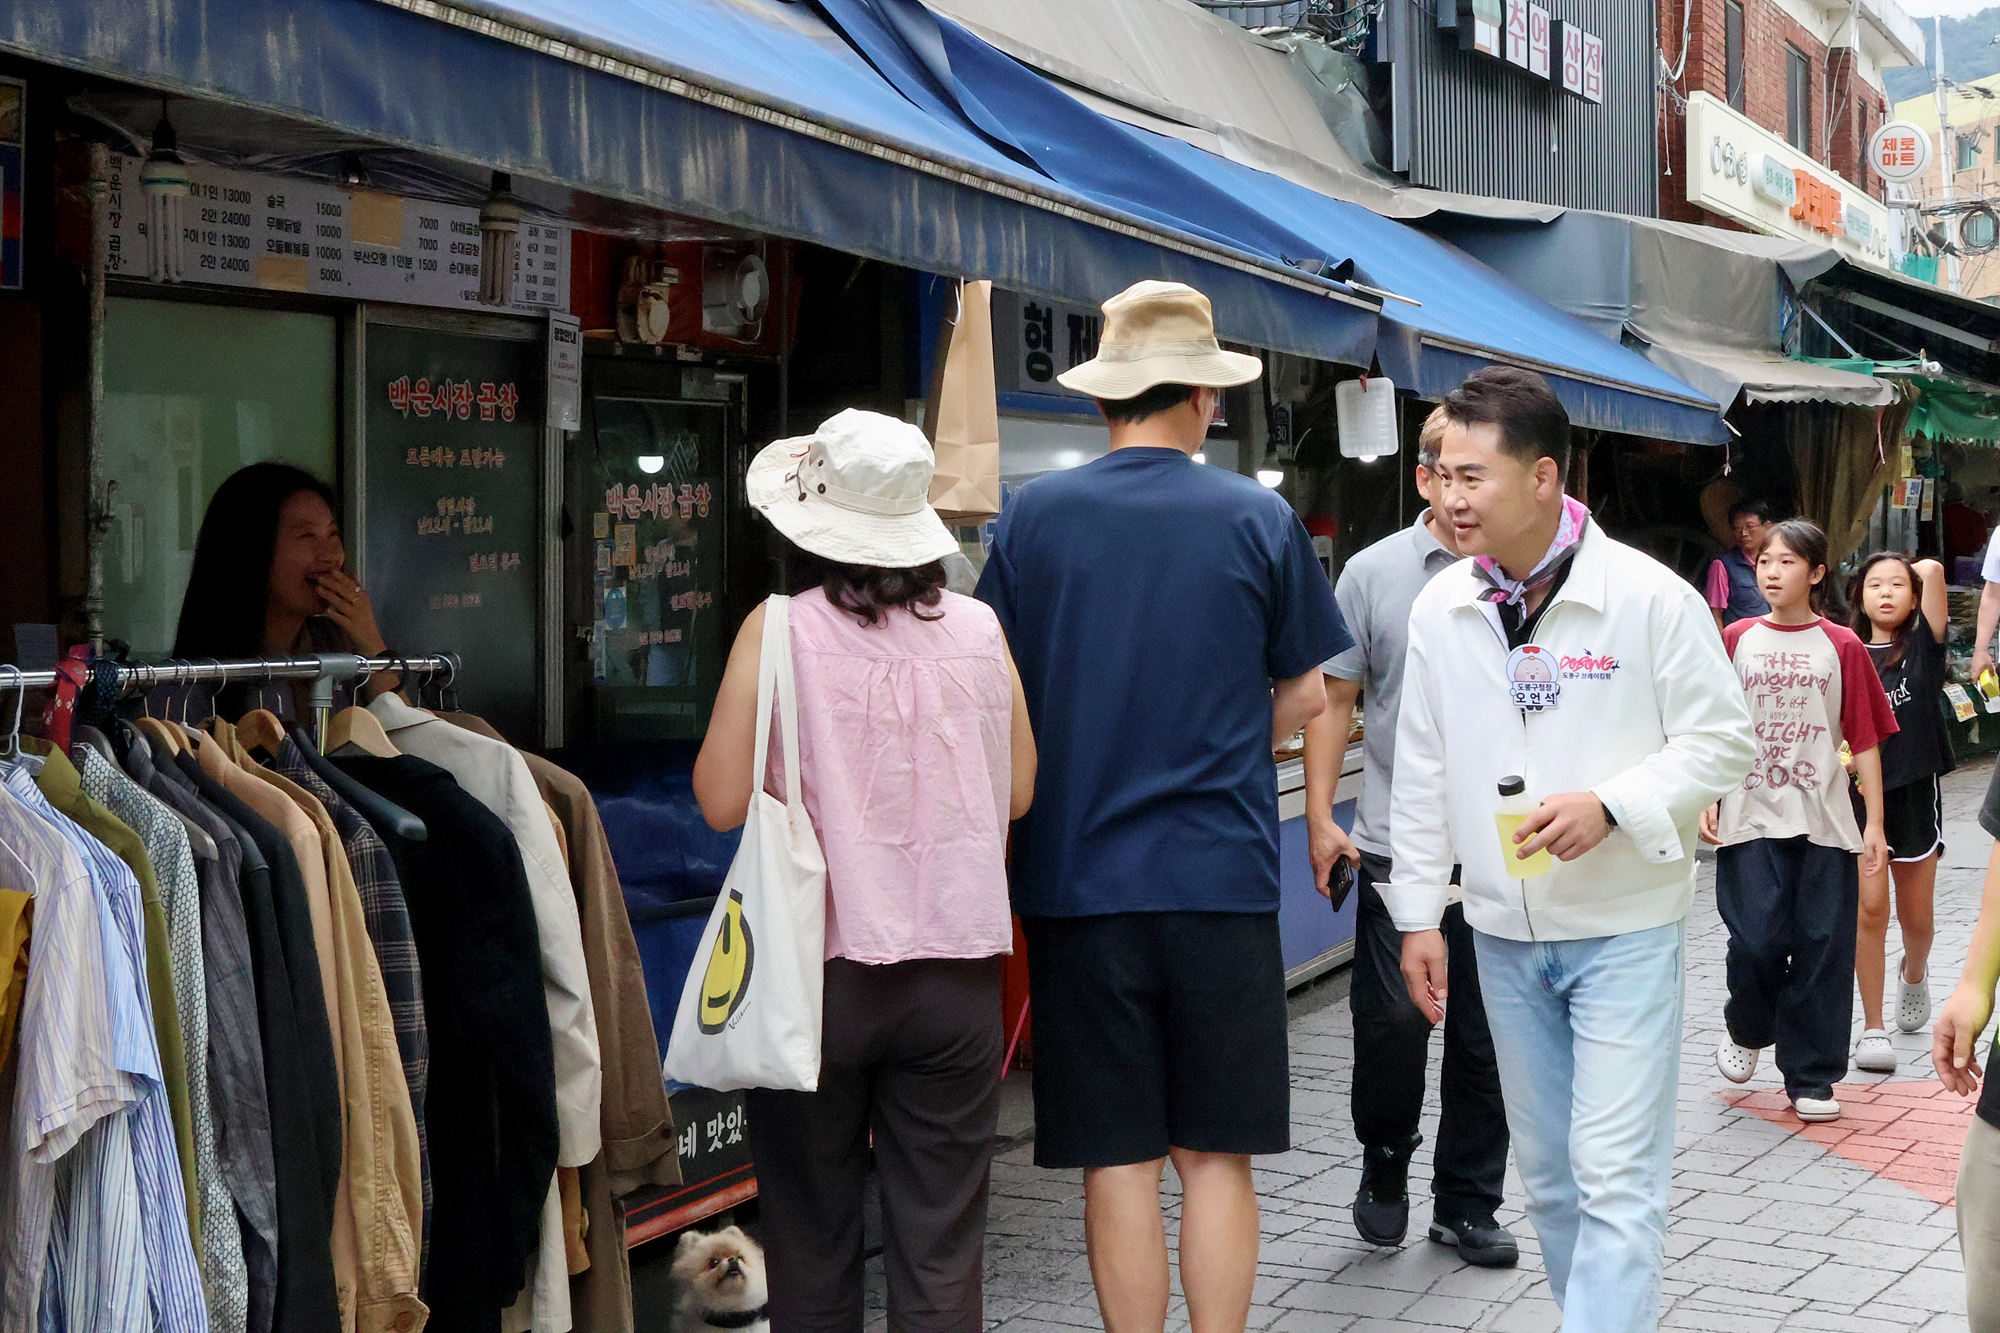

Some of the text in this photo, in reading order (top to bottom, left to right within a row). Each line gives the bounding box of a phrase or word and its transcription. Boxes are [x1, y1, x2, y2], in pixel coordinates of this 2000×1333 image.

[1508, 0, 1602, 96] 추억 상점
[1881, 138, 1915, 151] 제로
[1881, 153, 1915, 167] 마트
[109, 155, 122, 229] 백운시장
[223, 188, 251, 204] 13000
[201, 208, 251, 227] 2인 24000
[316, 202, 341, 218] 15000
[315, 223, 341, 238] 10000
[419, 216, 439, 231] 7000
[222, 234, 250, 249] 13000
[418, 238, 438, 252] 7000
[315, 245, 341, 261] 10000
[200, 254, 250, 272] 2인 24000
[418, 258, 438, 272] 1500
[543, 260, 557, 271] 2000
[319, 267, 341, 282] 5000
[542, 276, 556, 287] 2000
[542, 292, 556, 303] 2000
[388, 375, 520, 422] 백운시장 곱창
[406, 446, 506, 469] 모든메뉴 포장가능
[605, 482, 712, 520] 백운시장 곱창
[1559, 655, 1617, 673] DOBONG
[1754, 651, 1813, 671] THE
[1581, 672, 1612, 680] 브레이킹팀
[1517, 683, 1552, 692] 도봉구청장
[707, 1105, 747, 1152] 맛있
